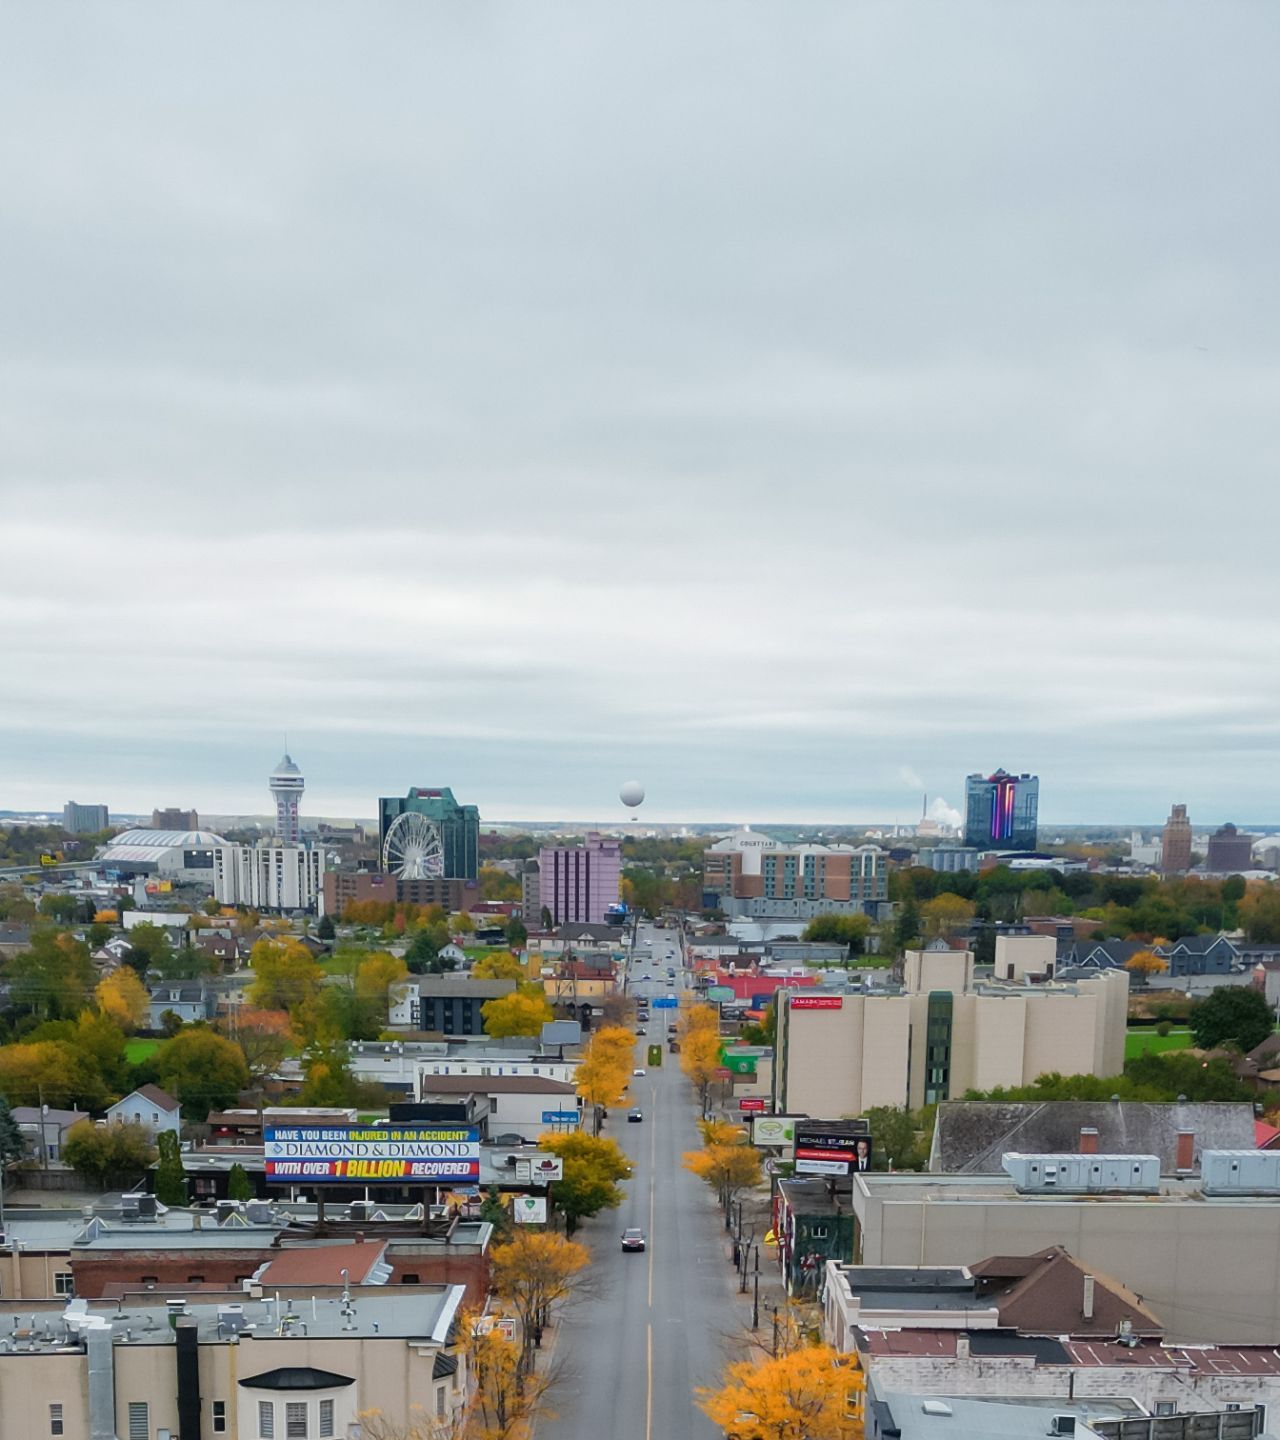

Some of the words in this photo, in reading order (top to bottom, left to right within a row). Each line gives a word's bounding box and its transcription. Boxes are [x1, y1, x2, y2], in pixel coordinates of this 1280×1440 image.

[275, 1131, 299, 1140] HAVE
[301, 1131, 320, 1140] YOU
[322, 1131, 346, 1140] BEEN
[349, 1131, 388, 1140] INJURED
[391, 1131, 401, 1140] IN
[403, 1131, 417, 1140] AN
[419, 1131, 469, 1140] ACCIDENT?
[286, 1144, 368, 1156] DIAMOND
[372, 1144, 385, 1156] &
[388, 1144, 470, 1156] DIAMOND
[275, 1162, 301, 1174] WITH
[303, 1162, 329, 1174] OVER
[335, 1161, 342, 1177] 1
[346, 1160, 406, 1177] BILLION
[411, 1163, 470, 1175] RECOVERED
